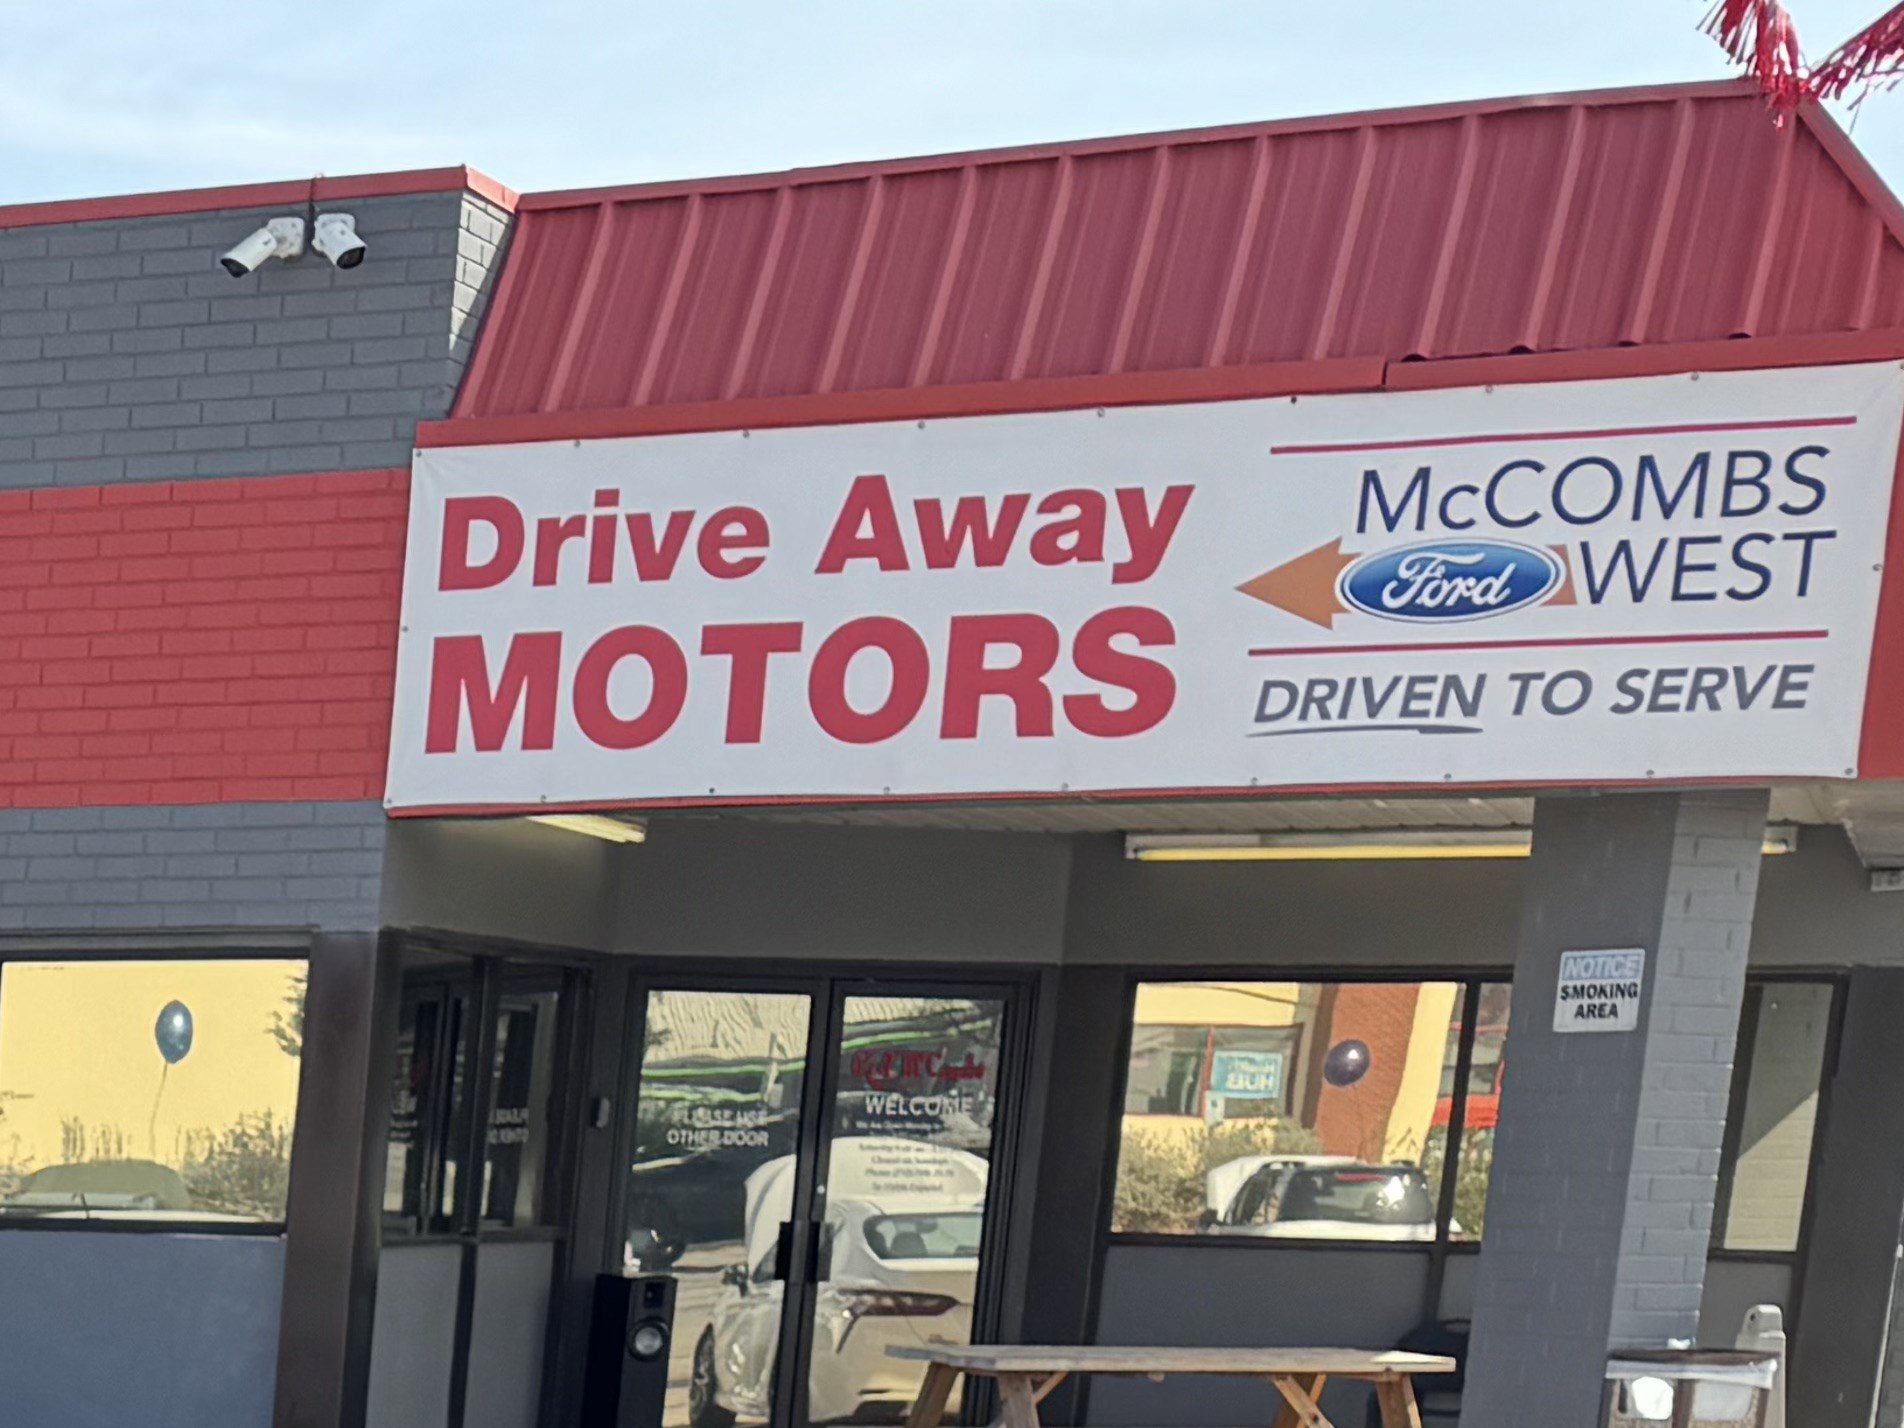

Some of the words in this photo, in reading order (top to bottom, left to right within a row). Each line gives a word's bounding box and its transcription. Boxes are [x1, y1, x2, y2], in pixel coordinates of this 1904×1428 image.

[1356, 445, 1832, 535] McCOMBS
[438, 488, 769, 592] Drive
[817, 476, 1194, 584] Away
[1381, 550, 1512, 609] Ford
[1579, 529, 1838, 606] WEST
[425, 606, 1177, 755] MOTORS
[1253, 672, 1488, 724] DRIVEN
[1507, 670, 1593, 717] TO
[1608, 663, 1816, 716] SERVE
[1560, 982, 1639, 1001] SMOKING
[1563, 956, 1641, 979] NOTICE
[1574, 1002, 1619, 1019] AREA
[865, 1094, 974, 1117] WELCOME
[723, 1130, 770, 1147] DOOR
